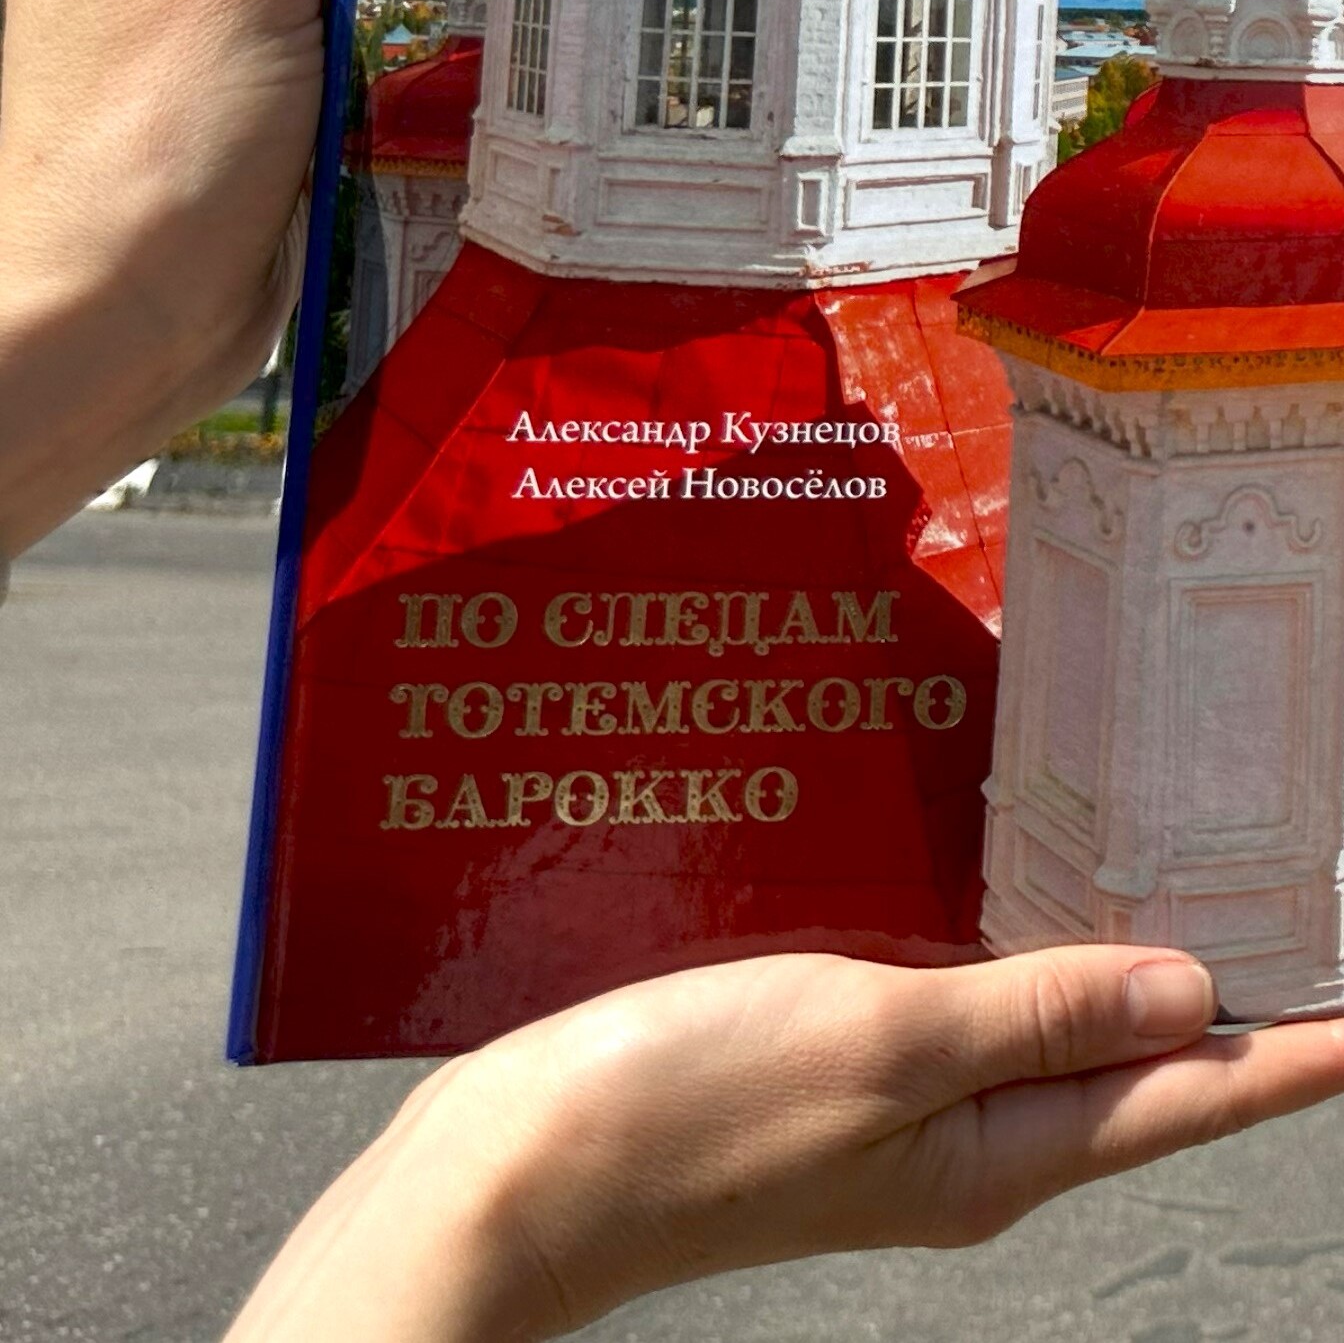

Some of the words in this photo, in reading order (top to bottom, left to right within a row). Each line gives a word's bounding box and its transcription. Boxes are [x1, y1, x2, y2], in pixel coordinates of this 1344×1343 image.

[506, 410, 711, 453] Александр
[721, 412, 901, 454] Кузнецов
[511, 468, 671, 500] Алексей
[680, 467, 888, 500] Новосёлов
[395, 591, 518, 648] ПО
[543, 590, 901, 656] СЛЕДАМ
[390, 675, 967, 738] ТОТЕМСКОГО
[380, 766, 799, 830] БАРОККО
